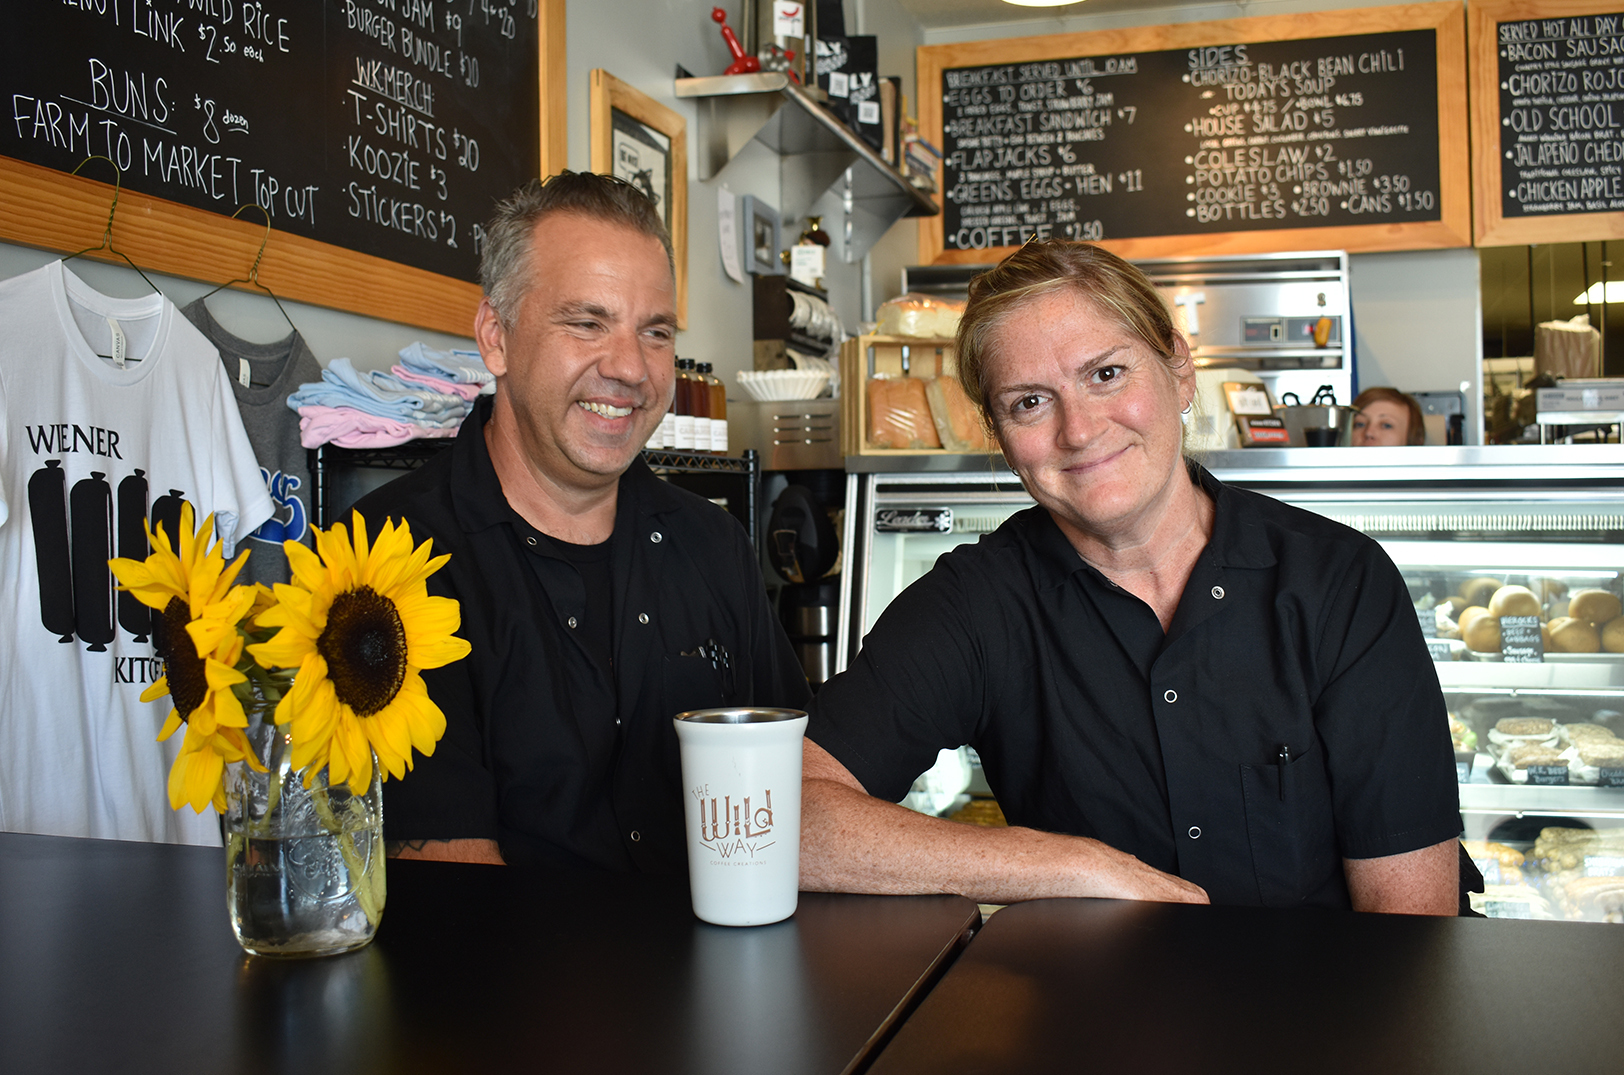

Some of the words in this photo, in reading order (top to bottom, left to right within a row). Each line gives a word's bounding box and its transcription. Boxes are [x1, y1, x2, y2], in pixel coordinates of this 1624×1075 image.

[242, 1, 290, 53] RICE
[445, 11, 463, 47] $9
[1499, 21, 1538, 42] SERVED
[1542, 20, 1566, 39] HOT
[1569, 17, 1591, 38] ALL
[1595, 15, 1619, 36] DAY
[198, 23, 237, 65] $2.50
[243, 46, 265, 63] each
[346, 0, 397, 53] BURGER
[401, 27, 453, 79] BUNDLE
[459, 51, 480, 88] $20
[1188, 45, 1249, 69] SIDES
[1507, 41, 1557, 62] BACON
[946, 66, 1016, 89] BREAKFAST
[1019, 62, 1062, 83] SERVED
[1317, 54, 1355, 77] BEAN
[1358, 48, 1405, 74] CHILI
[950, 86, 993, 107] EGGS
[998, 84, 1016, 103] TO
[1019, 80, 1068, 101] ORDER
[1075, 78, 1095, 96] $6
[1294, 75, 1336, 96] SOUP
[1508, 70, 1578, 96] CHORIZO
[89, 58, 176, 122] BUNS:
[194, 93, 220, 144] $8
[222, 109, 249, 130] dozen
[1214, 102, 1241, 118] CUP
[347, 89, 447, 161] T-SHIRTS
[452, 127, 480, 172] $20
[950, 112, 1034, 139] BREAKFAST
[1039, 108, 1113, 132] SANDWICH
[1117, 106, 1137, 126] $7
[1192, 114, 1247, 137] HOUSE
[1252, 110, 1309, 134] SALAD
[1312, 108, 1336, 129] $5
[1510, 107, 1543, 133] OLD
[1548, 102, 1621, 131] SCHOOL
[13, 94, 92, 157] FARM
[99, 119, 132, 171] TO
[144, 137, 242, 205] MARKET
[250, 168, 279, 217] TOP
[285, 184, 319, 226] CUT
[951, 145, 1053, 171] FLAPJACKS
[1058, 144, 1078, 164] $6
[1315, 143, 1338, 163] $2
[1584, 139, 1624, 164] CHED
[349, 135, 421, 190] KOOZIE
[430, 164, 448, 200] $3
[1195, 166, 1272, 187] POTATO
[1275, 161, 1329, 183] CHIPS
[1020, 177, 1064, 200] EGGS
[1075, 172, 1112, 196] HEN
[1118, 168, 1145, 192] $11
[1195, 181, 1256, 205] COOKIE
[1260, 182, 1281, 201] $3
[1302, 177, 1368, 199] BROWNIE
[1517, 178, 1579, 203] CHICKEN
[1580, 175, 1624, 200] APPLE
[348, 181, 438, 241] STICKERS
[440, 209, 459, 249] $2
[1196, 198, 1287, 224] BOTTLES
[1347, 193, 1393, 214] CANS
[956, 223, 1054, 250] COFFEE
[25, 423, 123, 460] WIENER
[691, 783, 710, 801] THE
[716, 838, 757, 859] WAY
